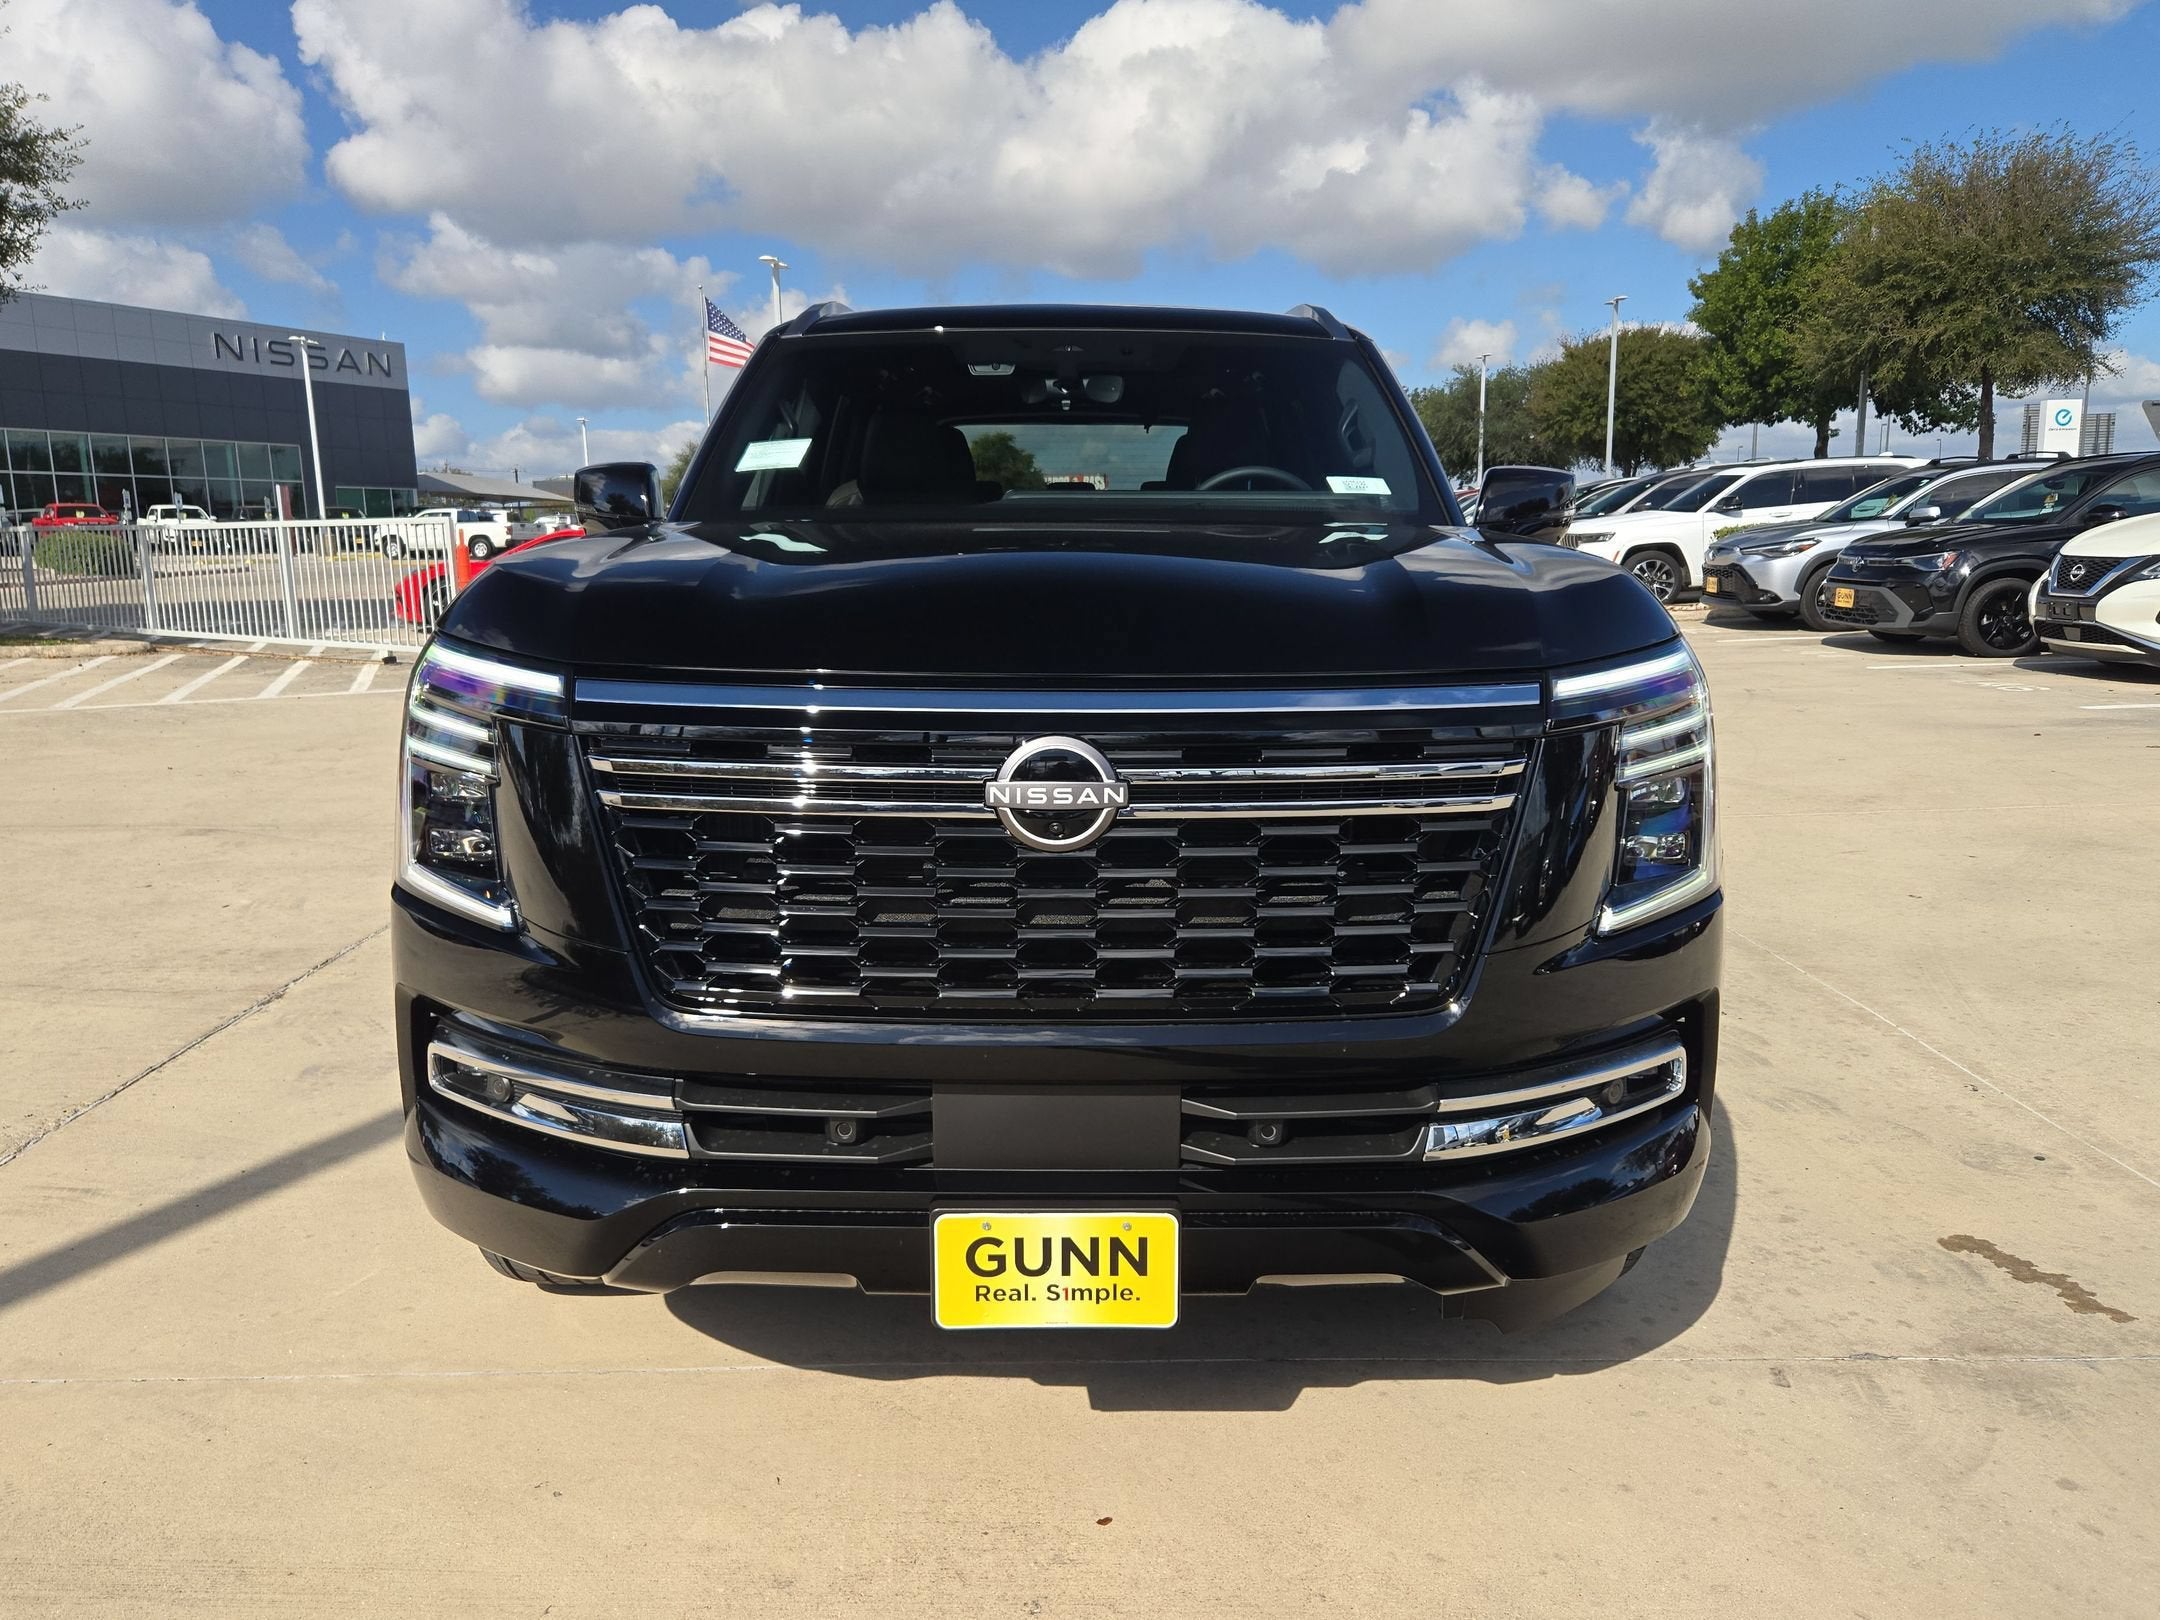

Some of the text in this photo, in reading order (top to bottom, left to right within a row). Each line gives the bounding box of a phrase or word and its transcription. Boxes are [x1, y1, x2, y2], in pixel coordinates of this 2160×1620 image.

[210, 331, 392, 378] NISSAN
[989, 786, 1125, 805] NISSAN
[965, 1236, 1148, 1278] GUNN
[975, 1284, 1037, 1302] Real.
